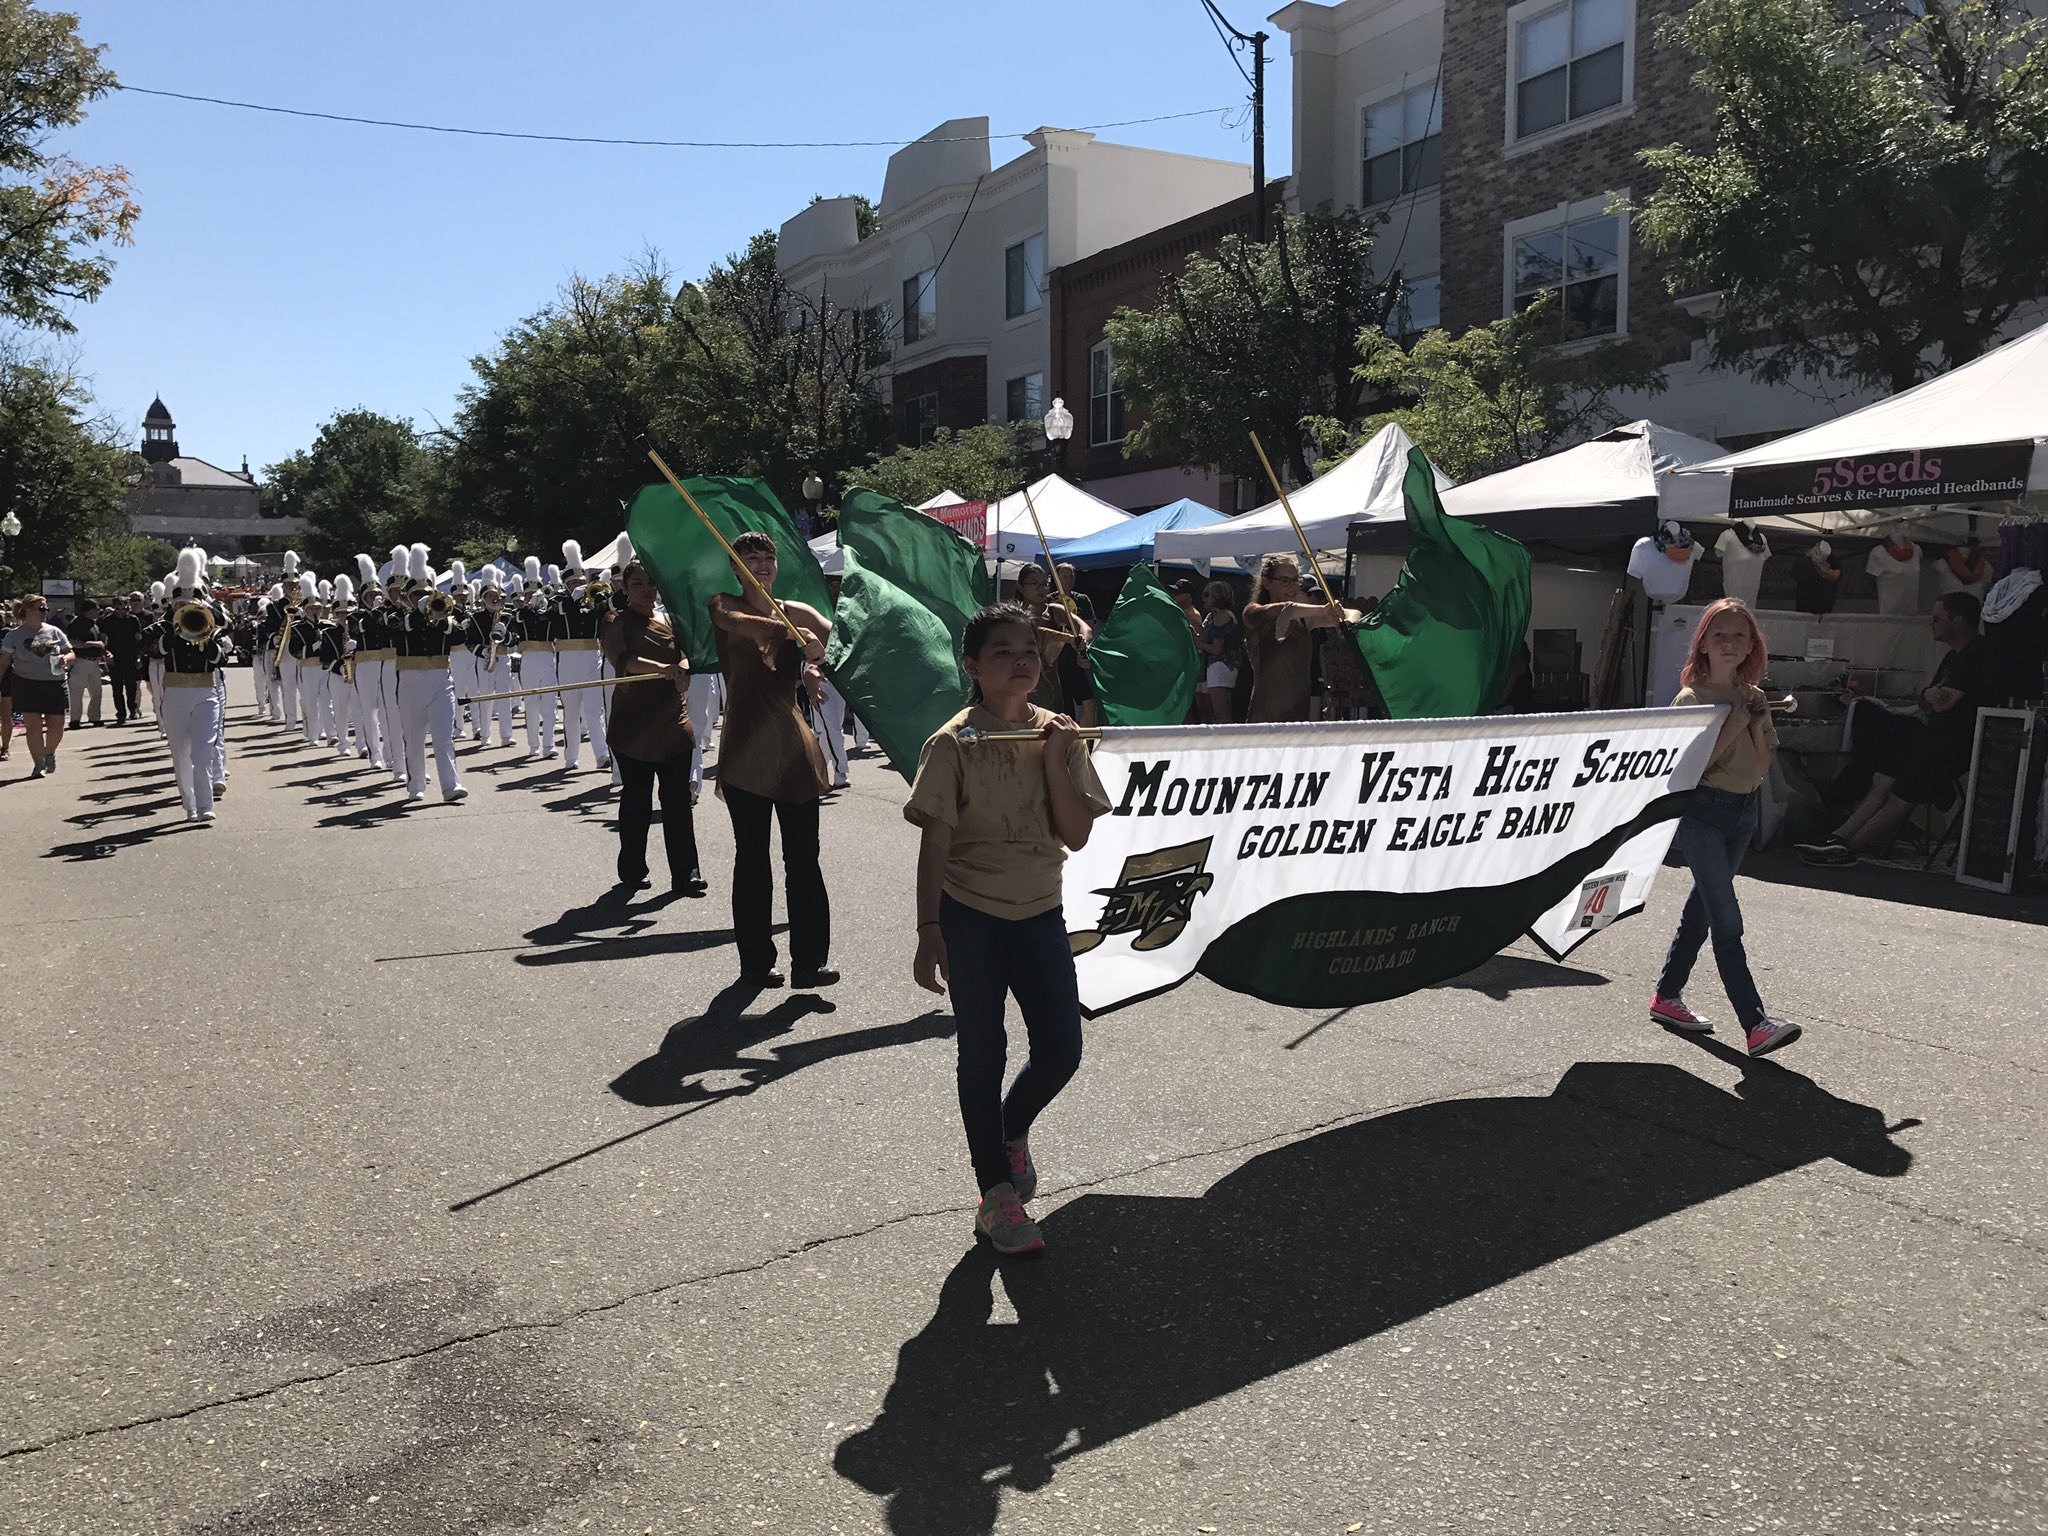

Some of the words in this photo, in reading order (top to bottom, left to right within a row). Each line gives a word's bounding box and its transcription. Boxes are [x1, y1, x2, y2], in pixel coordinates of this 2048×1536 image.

[1812, 449, 1942, 495] 5Seeds
[1734, 494, 1795, 509] Handmade
[1796, 493, 1842, 505] Scarves
[1843, 490, 1854, 501] &
[1857, 484, 1940, 501] Re-Purposed
[1944, 477, 2024, 494] Headbands
[1112, 760, 1330, 816] MOUNTAIN
[1358, 751, 1453, 804] VISTA
[1473, 745, 1559, 797] HIGH
[1572, 739, 1679, 788] SCHOOL
[1237, 818, 1377, 860] GOLDEN
[1386, 809, 1492, 851] EAGLE
[1497, 801, 1575, 839] BAND
[1291, 926, 1397, 950] HIGHLANDS
[1406, 916, 1461, 940] RANCH
[1328, 948, 1416, 975] COLORADO
